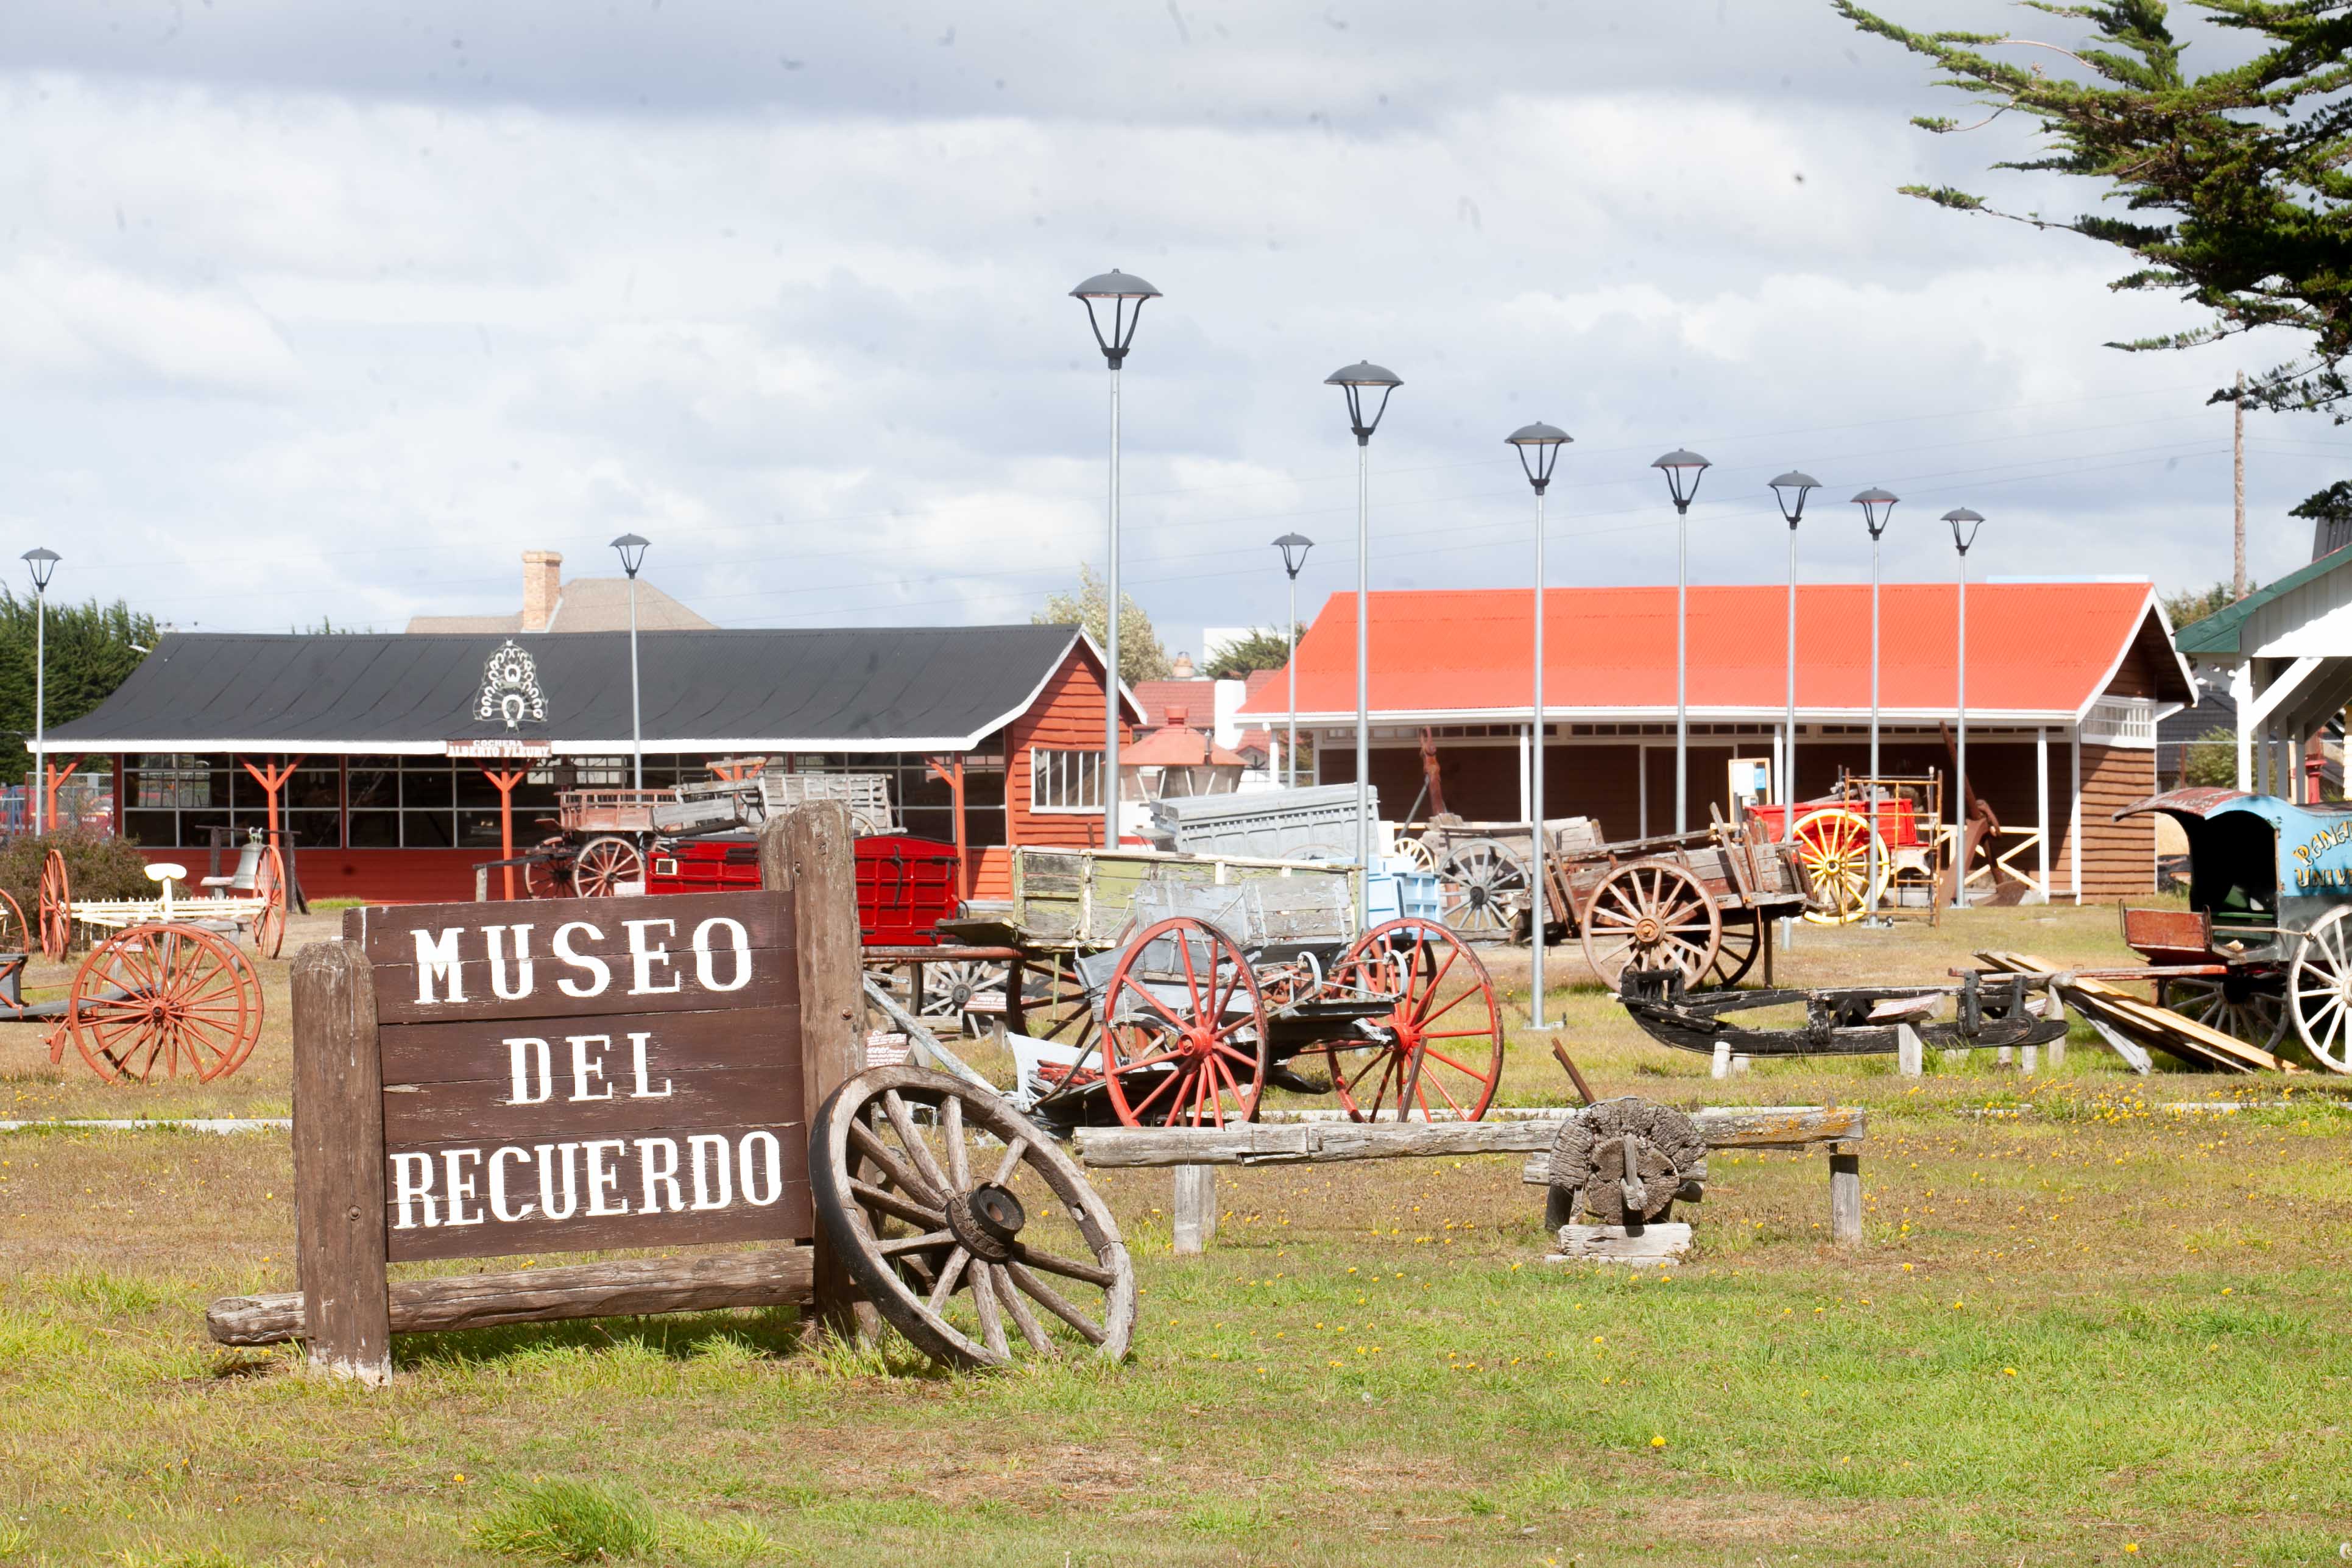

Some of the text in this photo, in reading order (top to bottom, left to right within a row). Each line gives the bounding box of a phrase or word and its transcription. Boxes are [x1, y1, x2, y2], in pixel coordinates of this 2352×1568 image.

[448, 746, 550, 757] ALBERTO FLEURY
[2291, 820, 2352, 867] PANA
[2294, 867, 2352, 888] UNIV
[409, 917, 753, 1004] MUSEO
[503, 1032, 672, 1105] DEL
[389, 1131, 782, 1230] RECUERDO
